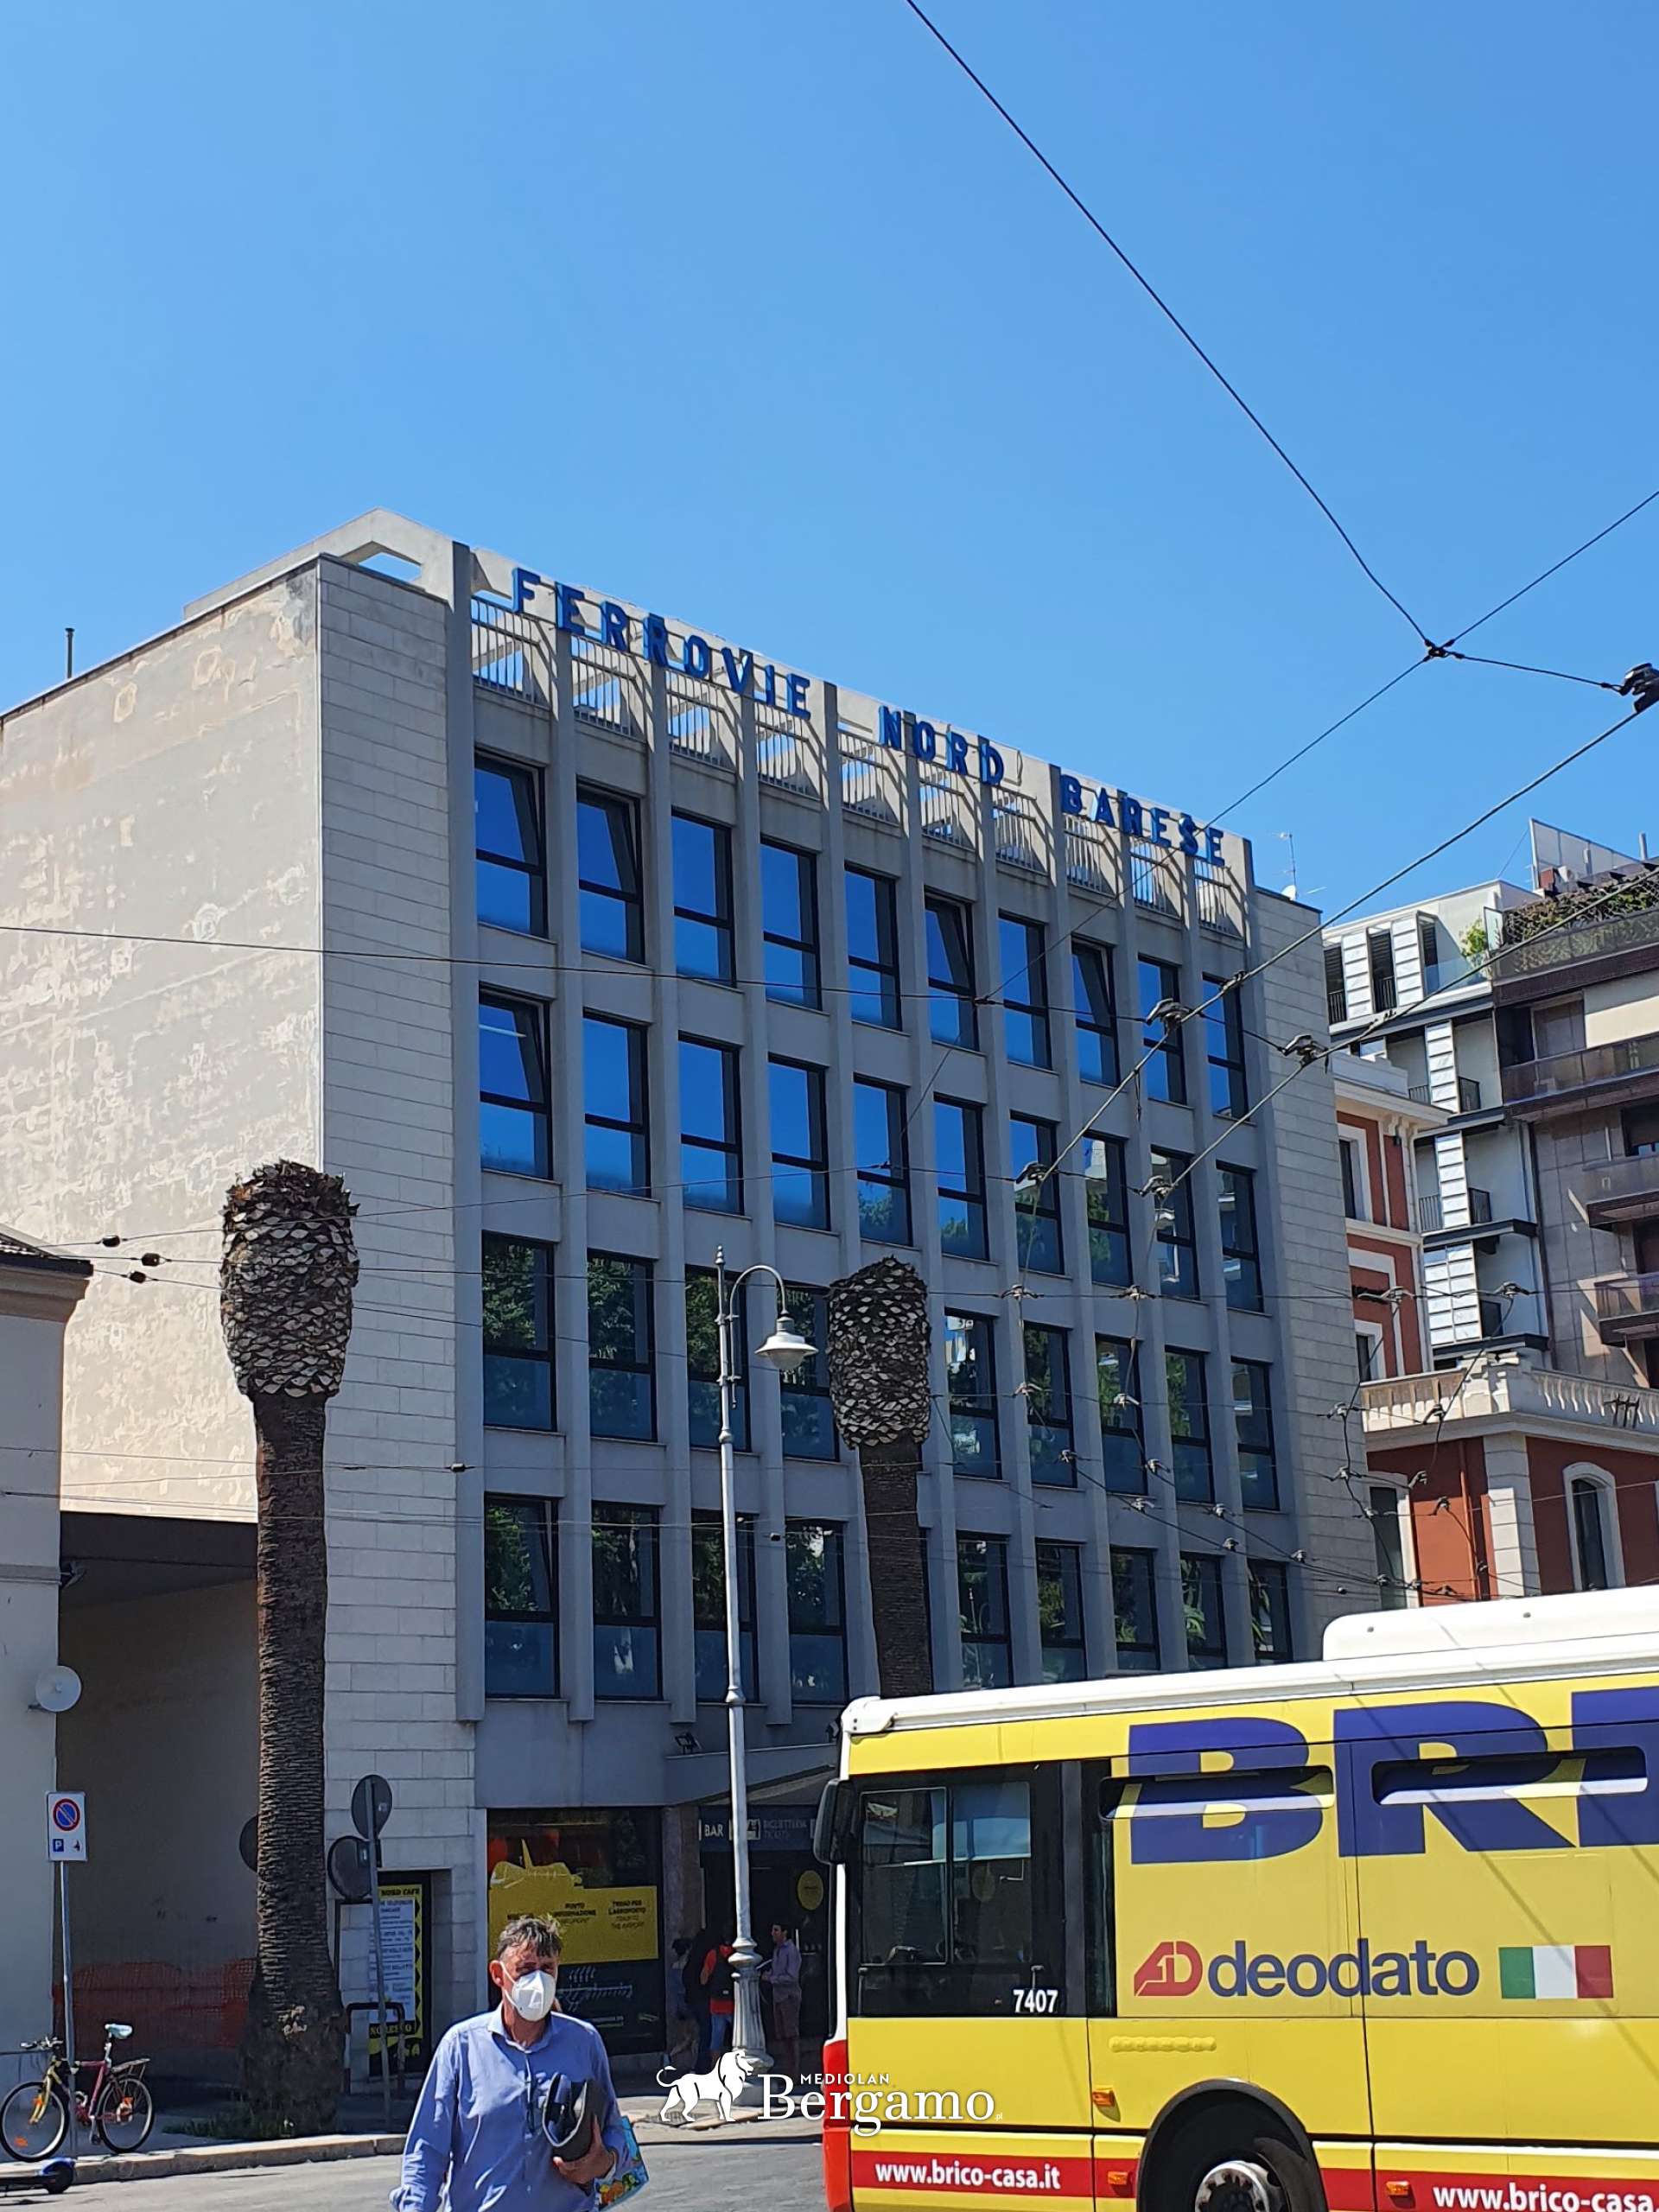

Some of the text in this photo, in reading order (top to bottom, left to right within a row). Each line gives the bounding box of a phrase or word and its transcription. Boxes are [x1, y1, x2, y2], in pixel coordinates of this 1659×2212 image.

[512, 566, 1226, 866] FERROVIE NORD BARESE
[704, 1824, 724, 1837] BAR
[1208, 1938, 1479, 1998] deodato
[1013, 1989, 1058, 2013] 7407
[874, 2158, 1061, 2190] www.brico-casa.it
